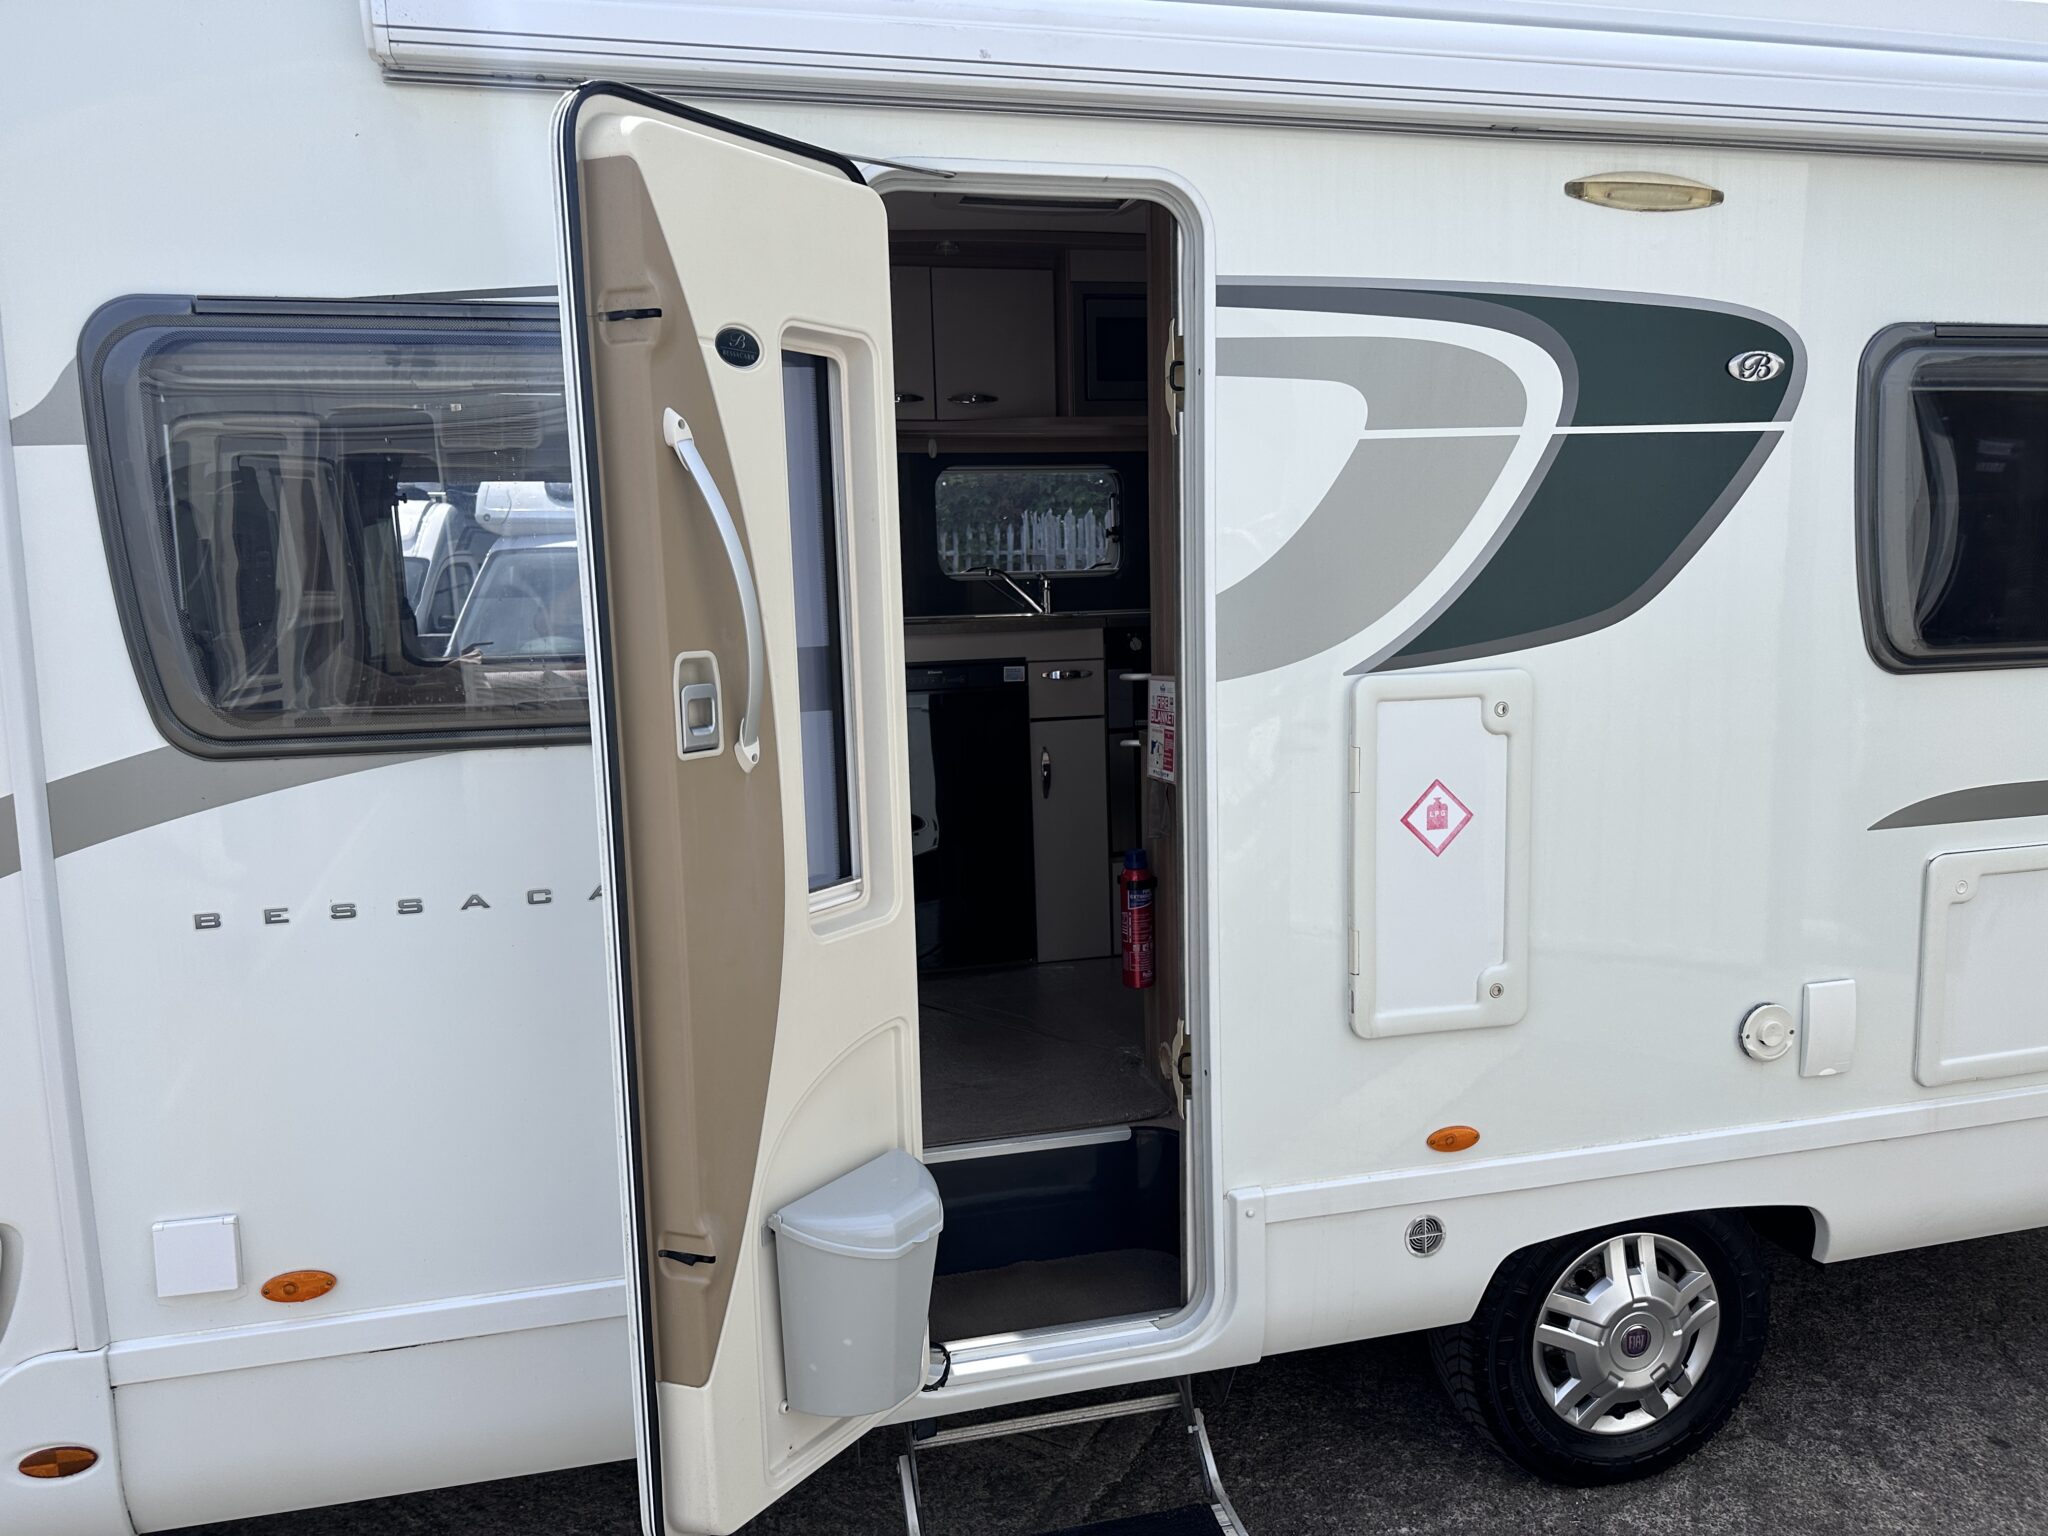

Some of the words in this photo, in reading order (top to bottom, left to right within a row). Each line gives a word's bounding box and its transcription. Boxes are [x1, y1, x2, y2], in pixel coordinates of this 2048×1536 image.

[1157, 696, 1169, 710] FIRE
[1151, 710, 1174, 725] BLANKET
[1429, 810, 1446, 818] LPG
[1628, 1334, 1645, 1350] FIAT
